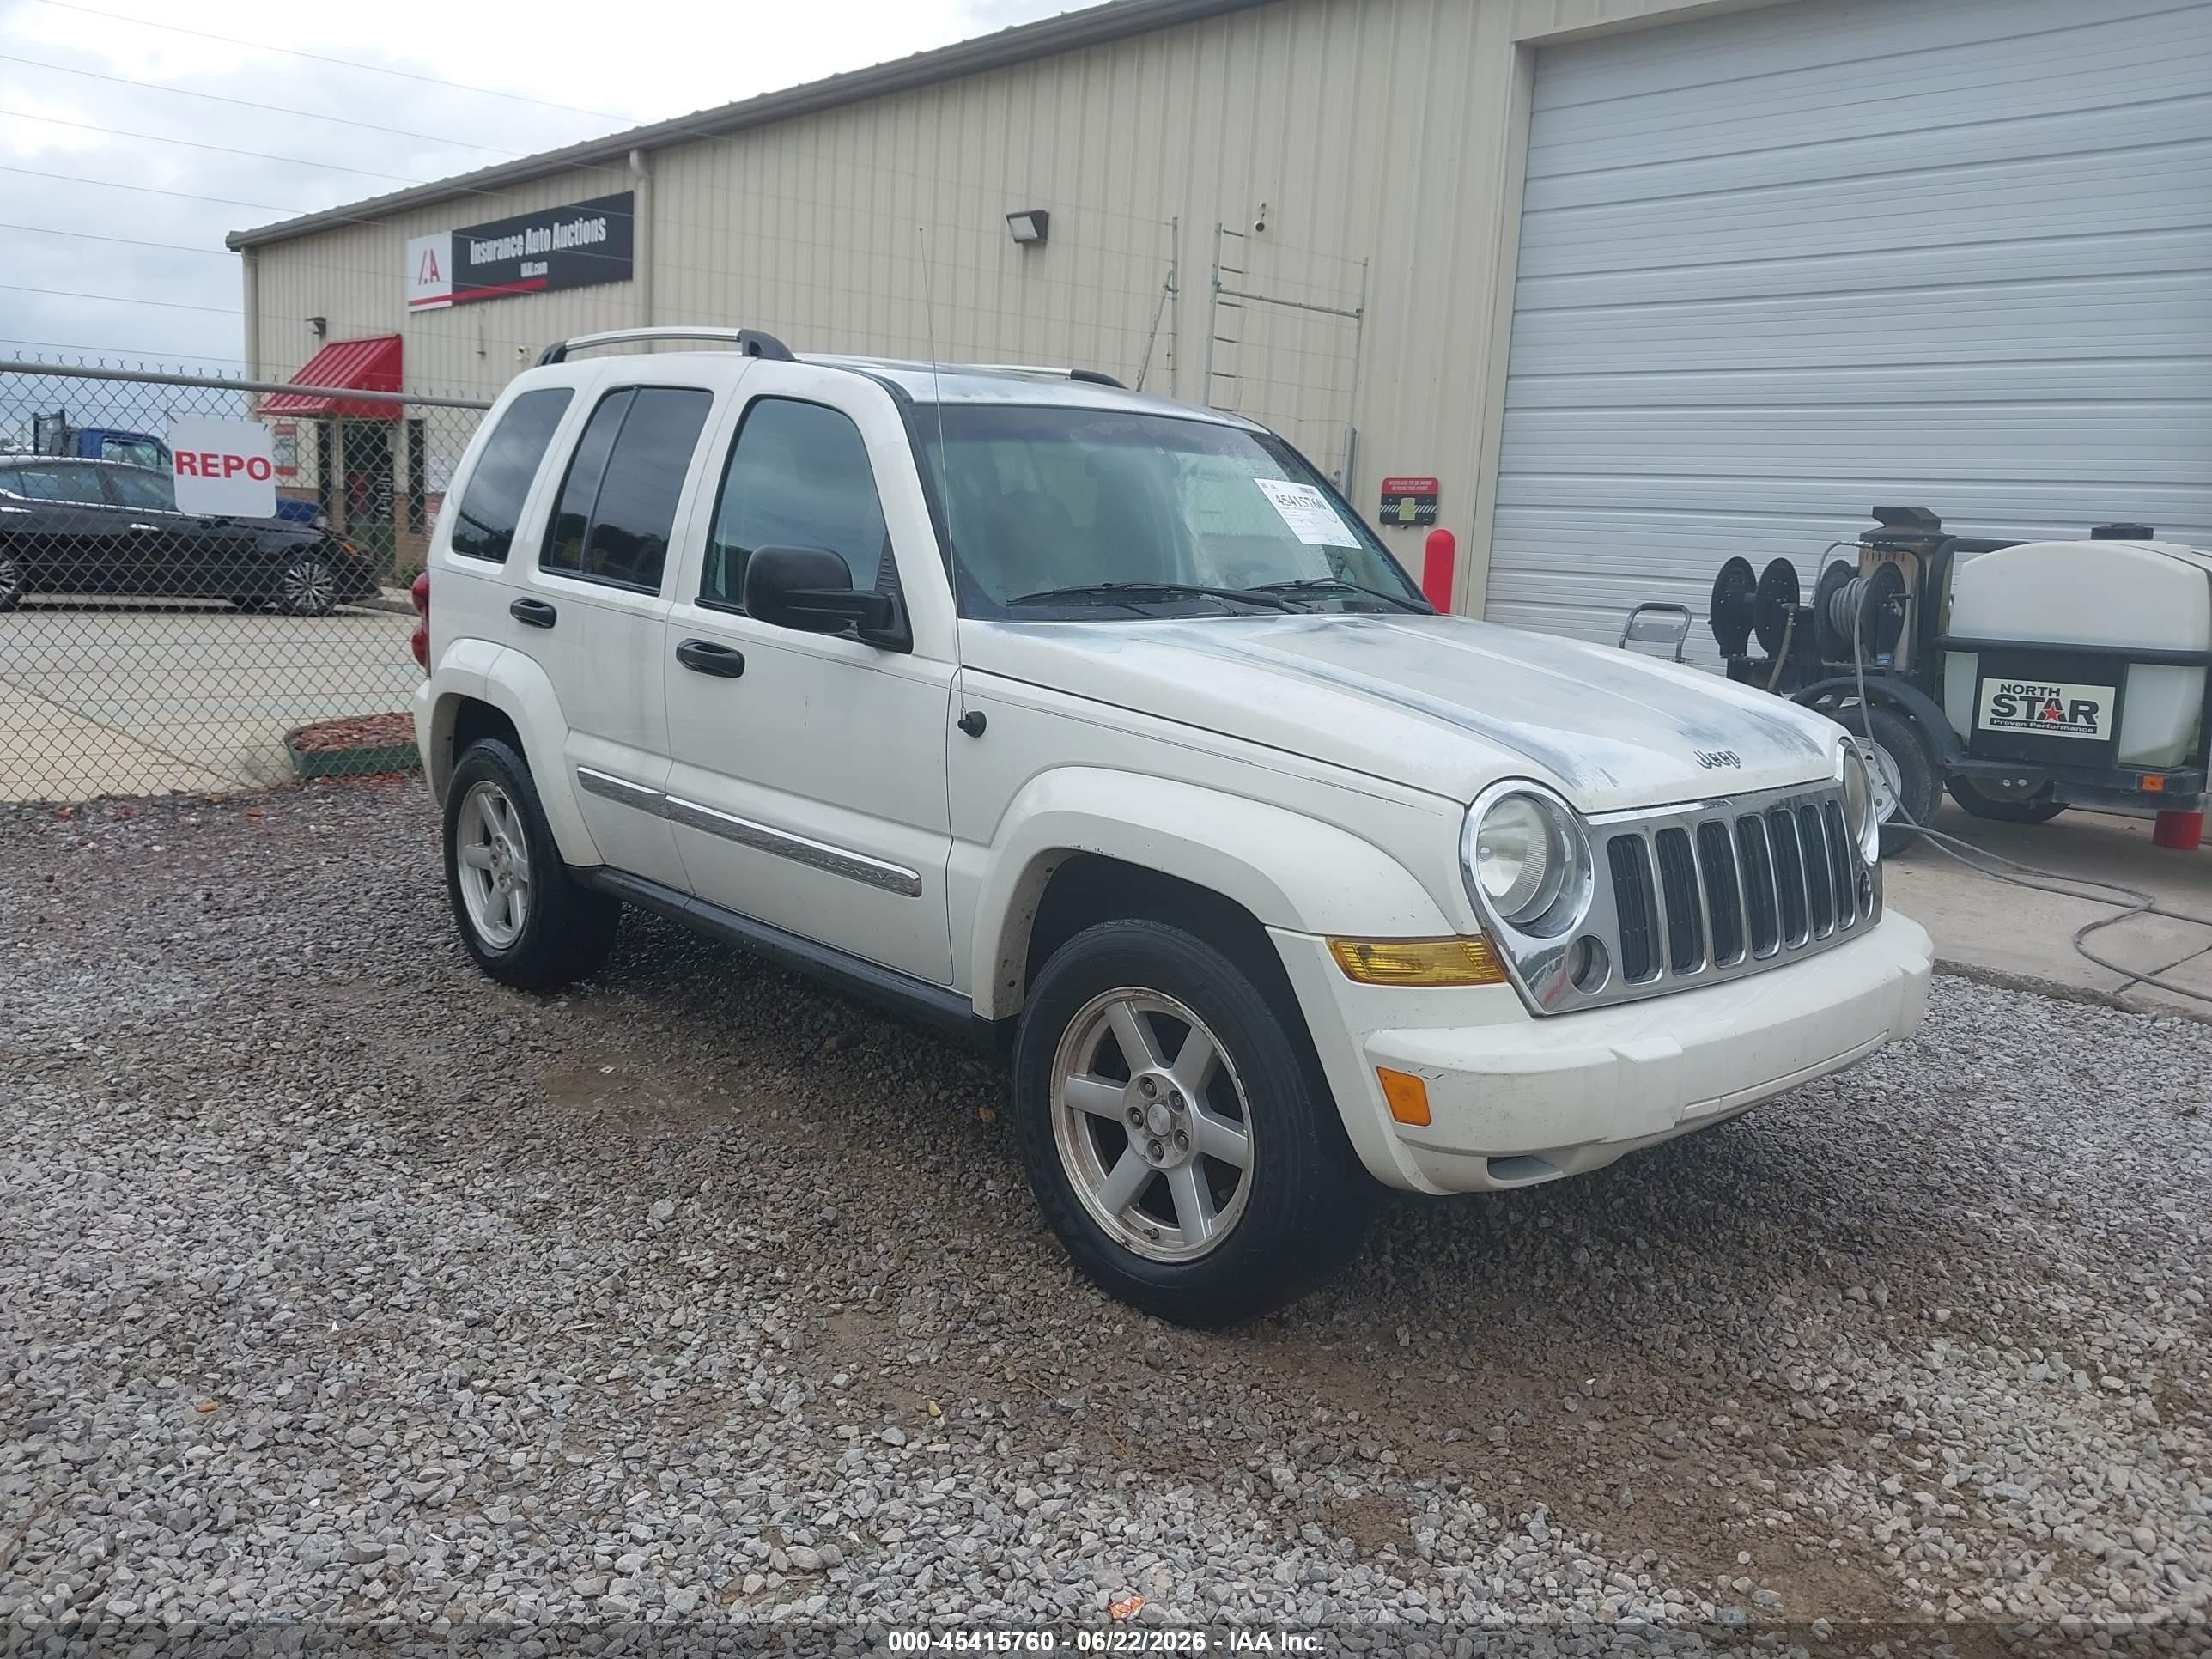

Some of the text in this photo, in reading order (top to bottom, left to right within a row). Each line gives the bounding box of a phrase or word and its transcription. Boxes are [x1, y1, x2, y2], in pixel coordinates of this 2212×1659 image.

[470, 216, 606, 265] Insurance Auto Auctions
[174, 451, 272, 481] REPO
[1275, 494, 1327, 510] 45415760
[2000, 684, 2061, 697] NORTH
[1990, 693, 2099, 726] STAR
[1993, 719, 2094, 732] Proven Performance
[1692, 750, 1741, 769] Jeep
